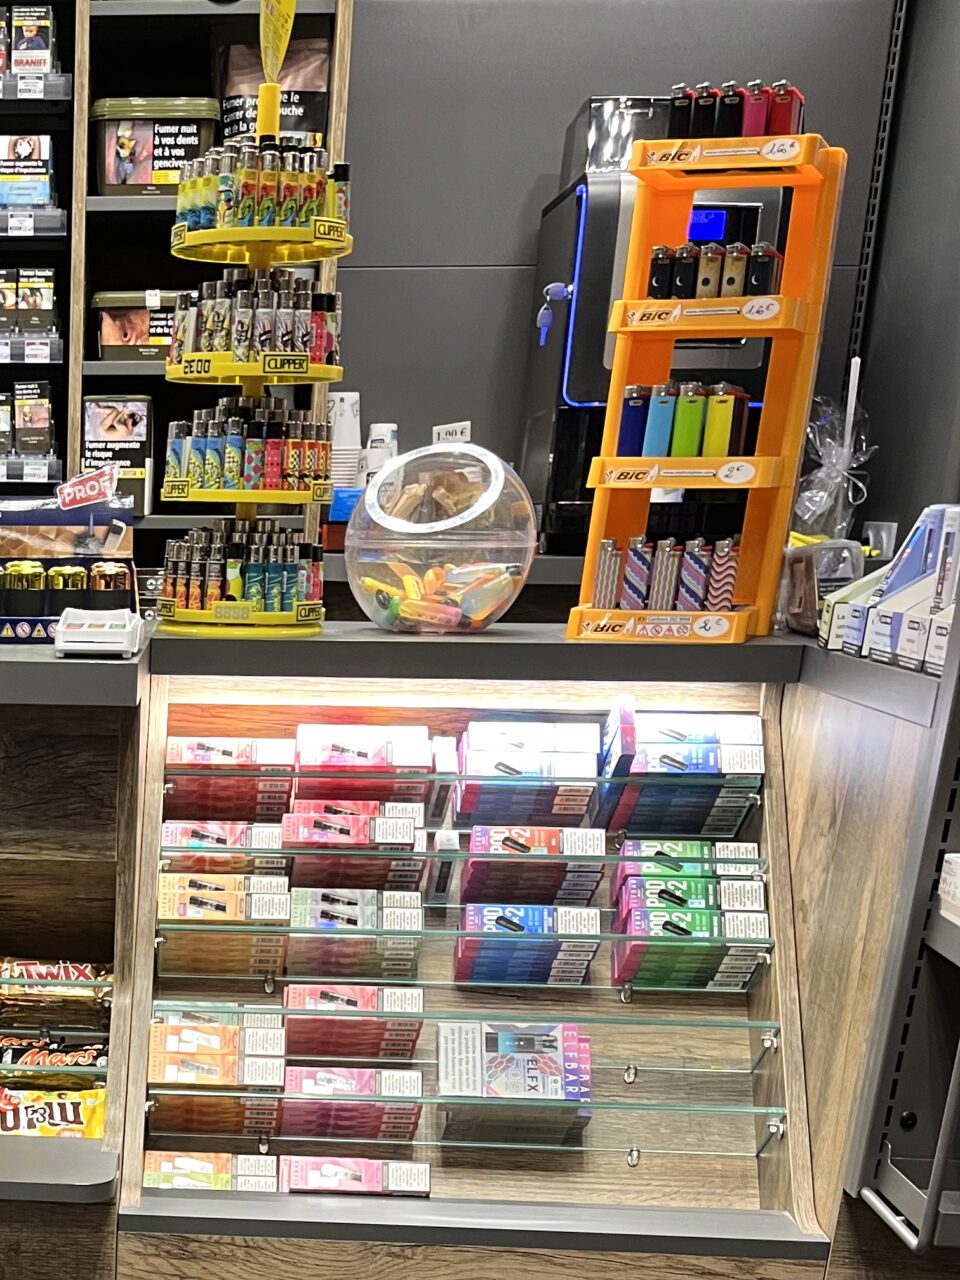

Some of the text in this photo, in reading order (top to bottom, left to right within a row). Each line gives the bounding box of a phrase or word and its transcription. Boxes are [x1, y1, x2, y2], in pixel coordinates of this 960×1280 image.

[13, 58, 48, 68] BRANIFF
[290, 92, 300, 103] le
[154, 124, 197, 133] Fumer nuit
[154, 135, 199, 145] à vos dents
[154, 148, 163, 156] et
[164, 146, 170, 156] à
[658, 151, 689, 162] BIC
[317, 224, 345, 238] CLIPPER
[639, 311, 670, 322] BIC
[267, 357, 306, 370] CLIPPER
[460, 427, 468, 438] €
[85, 441, 140, 452] Fumer augmente
[85, 450, 113, 460] le risque
[616, 471, 648, 481] BIC
[61, 476, 113, 503] PROF
[593, 623, 625, 633] BIC
[646, 880, 667, 908] POD
[19, 1048, 97, 1067] Mars
[563, 1030, 578, 1094] ELFBAR
[527, 1059, 539, 1093] ELFX
